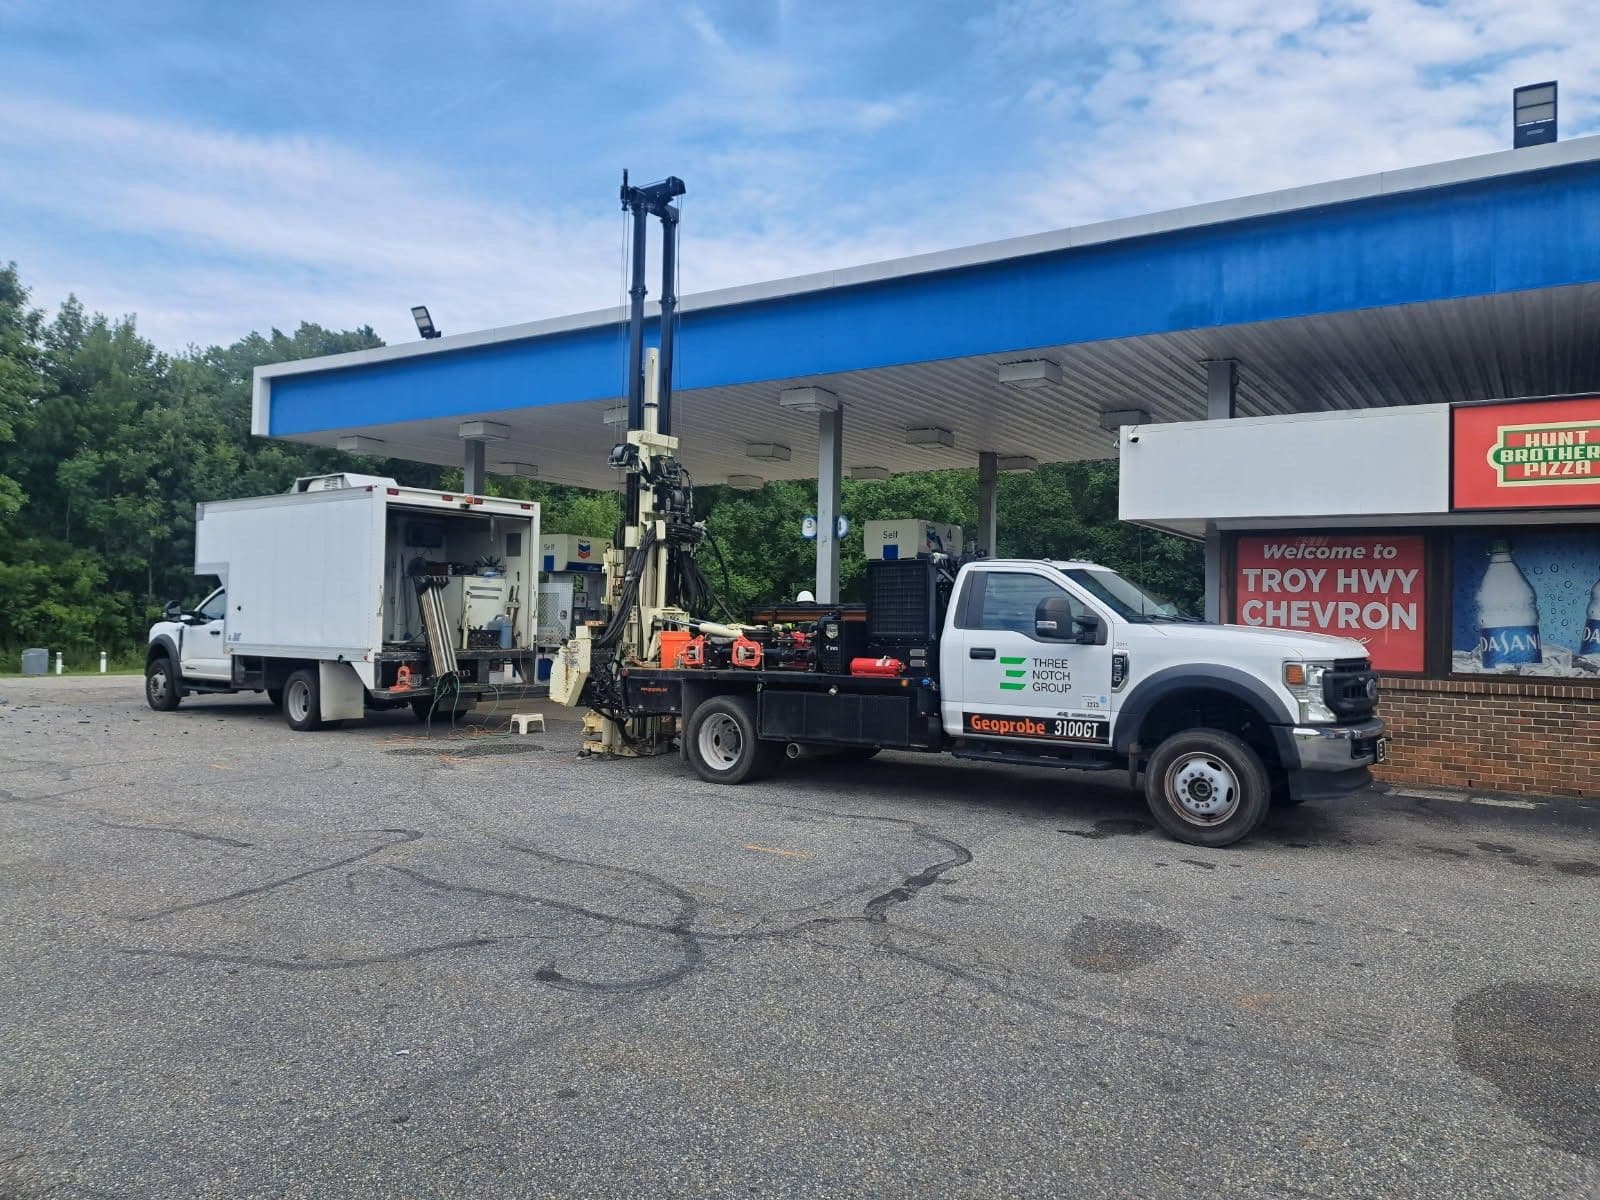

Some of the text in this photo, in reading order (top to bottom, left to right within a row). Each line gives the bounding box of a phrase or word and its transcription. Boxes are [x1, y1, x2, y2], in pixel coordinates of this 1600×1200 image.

[1525, 430, 1589, 448] HUNT
[1524, 460, 1591, 477] PIZZA
[806, 520, 813, 528] 3
[882, 530, 898, 539] Self
[946, 528, 952, 542] 4
[1263, 543, 1397, 560] Welcome to
[1242, 567, 1419, 594] TROY HWY
[1242, 599, 1417, 631] CHEVRON
[1032, 657, 1069, 669] THREE
[1032, 670, 1071, 681] NOTCH
[1032, 681, 1072, 693] GROUP
[970, 714, 1047, 735] Geoprobe
[1054, 719, 1099, 738] 3100GT
